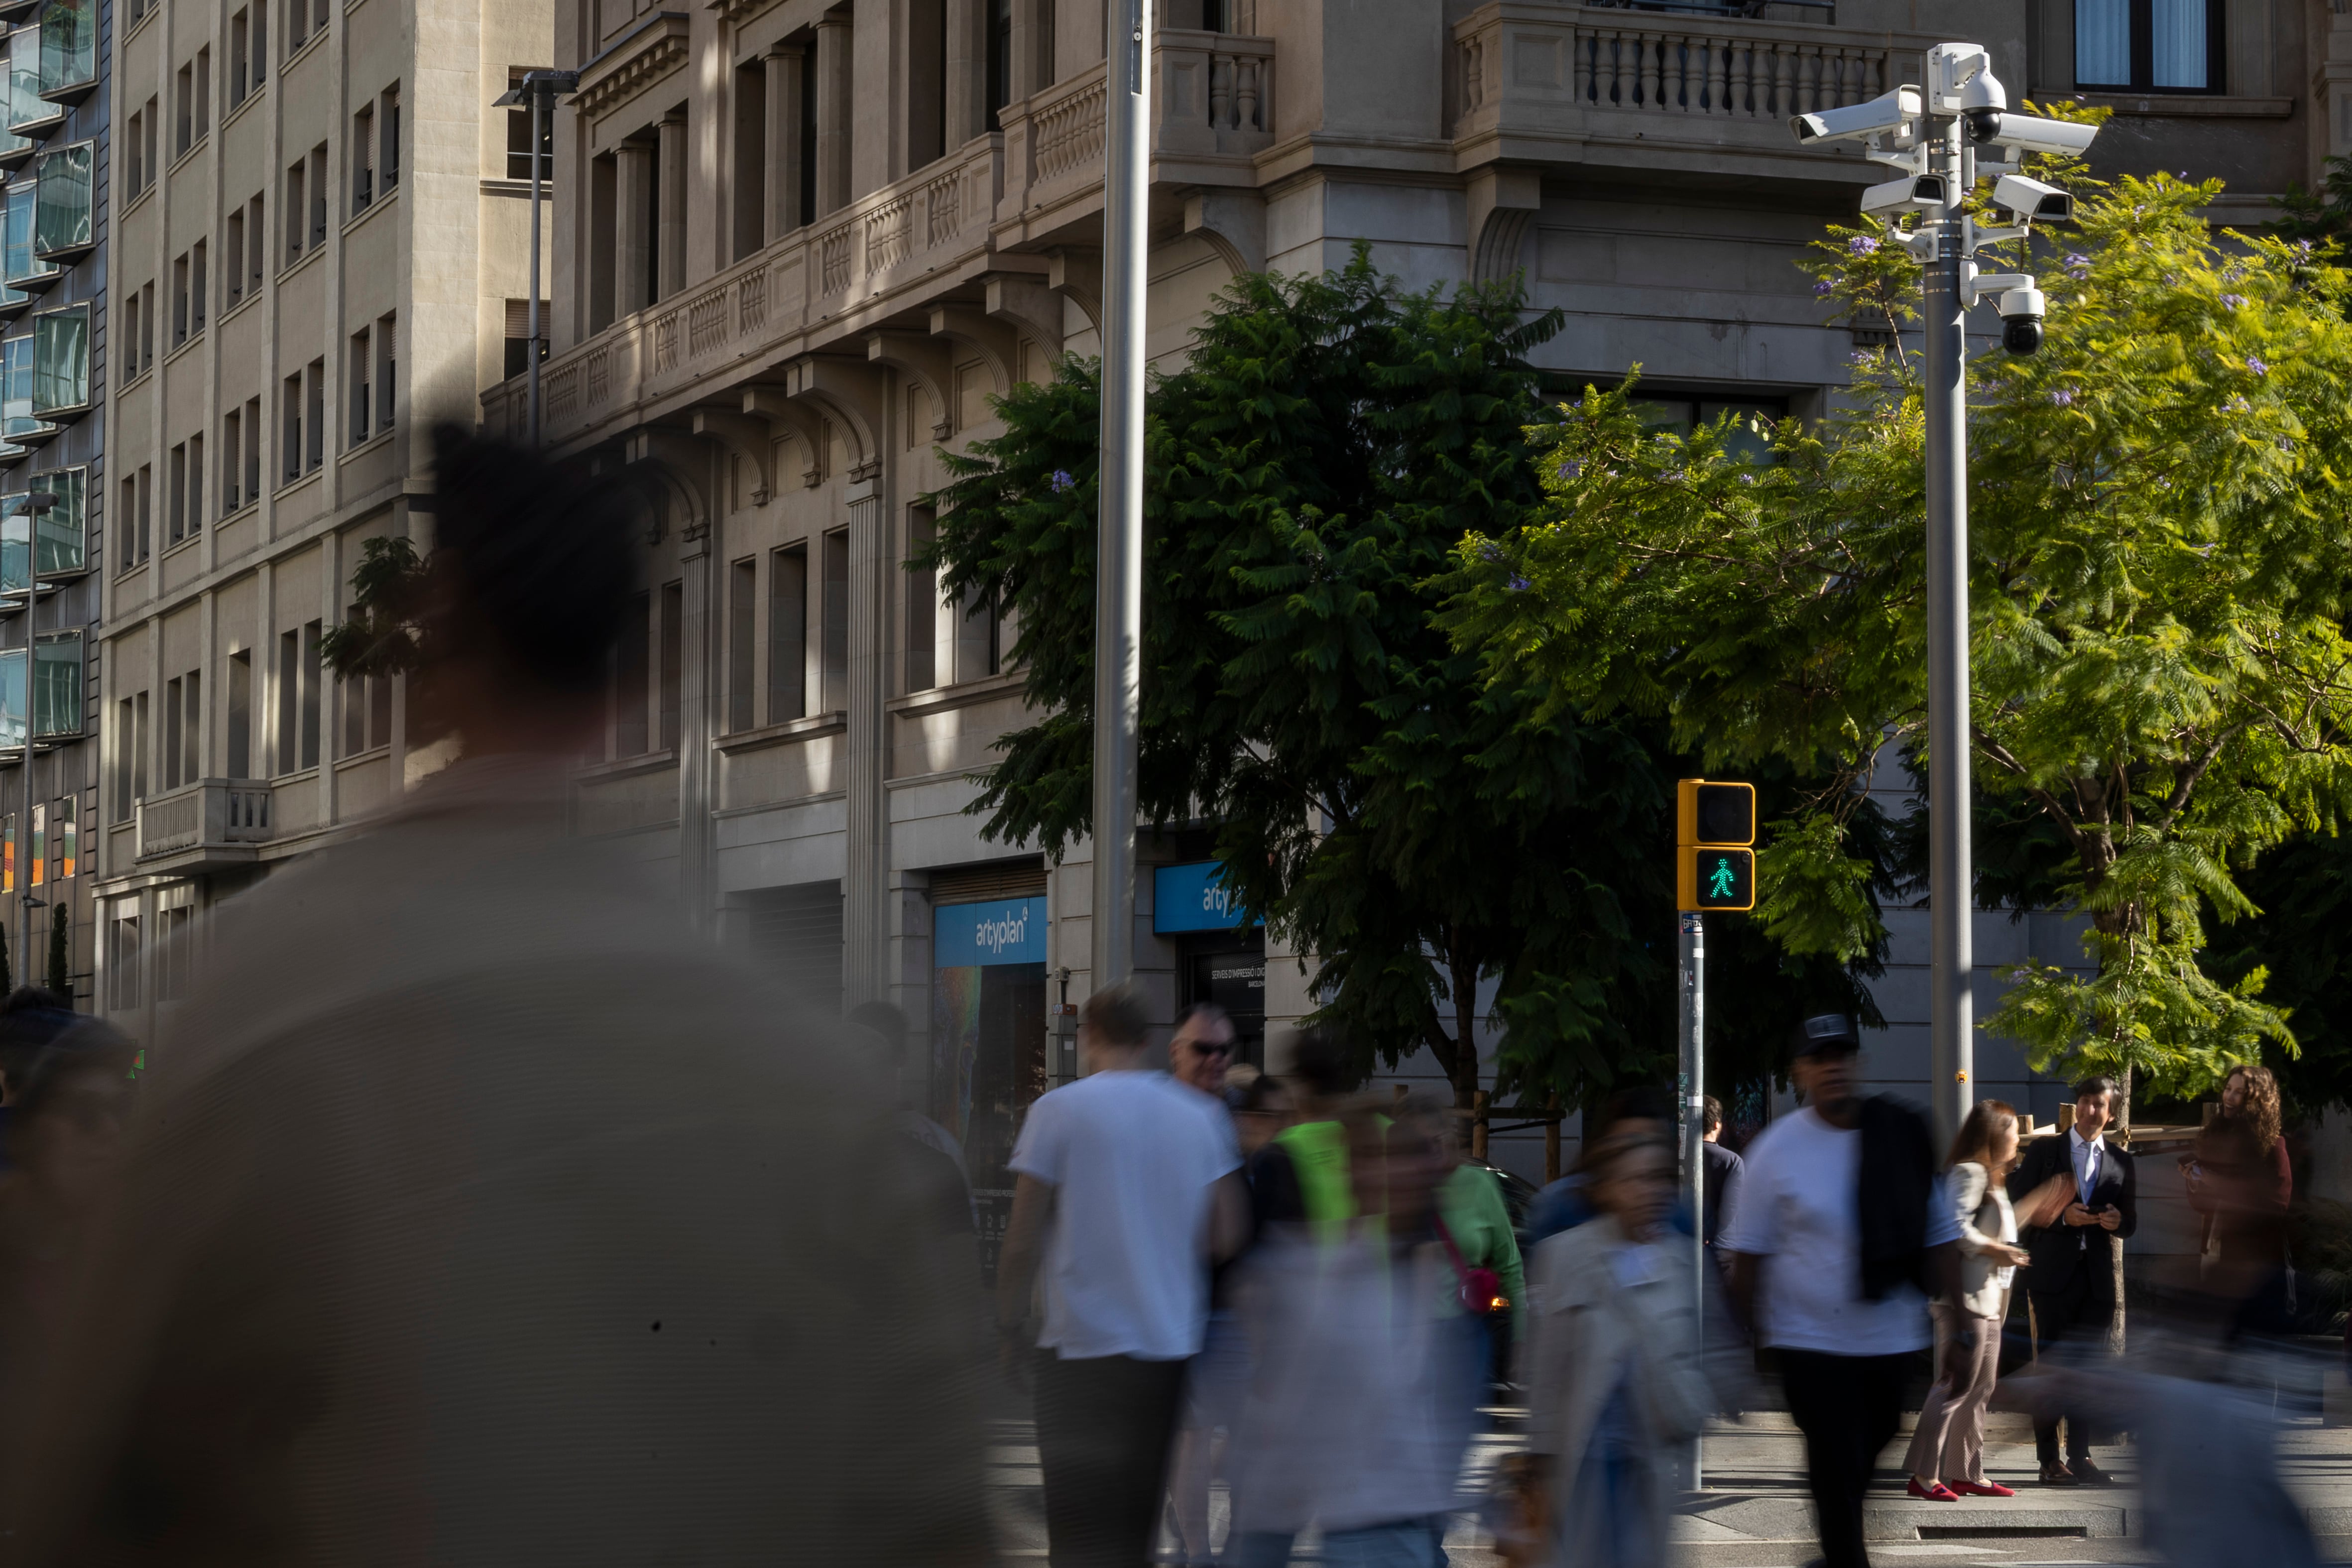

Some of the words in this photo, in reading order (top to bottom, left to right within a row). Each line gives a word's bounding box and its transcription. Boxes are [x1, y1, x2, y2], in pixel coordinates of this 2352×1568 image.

[1203, 882, 1240, 919] arty
[976, 911, 1024, 954] artyplan
[1212, 970, 1228, 979] SERVEIS
